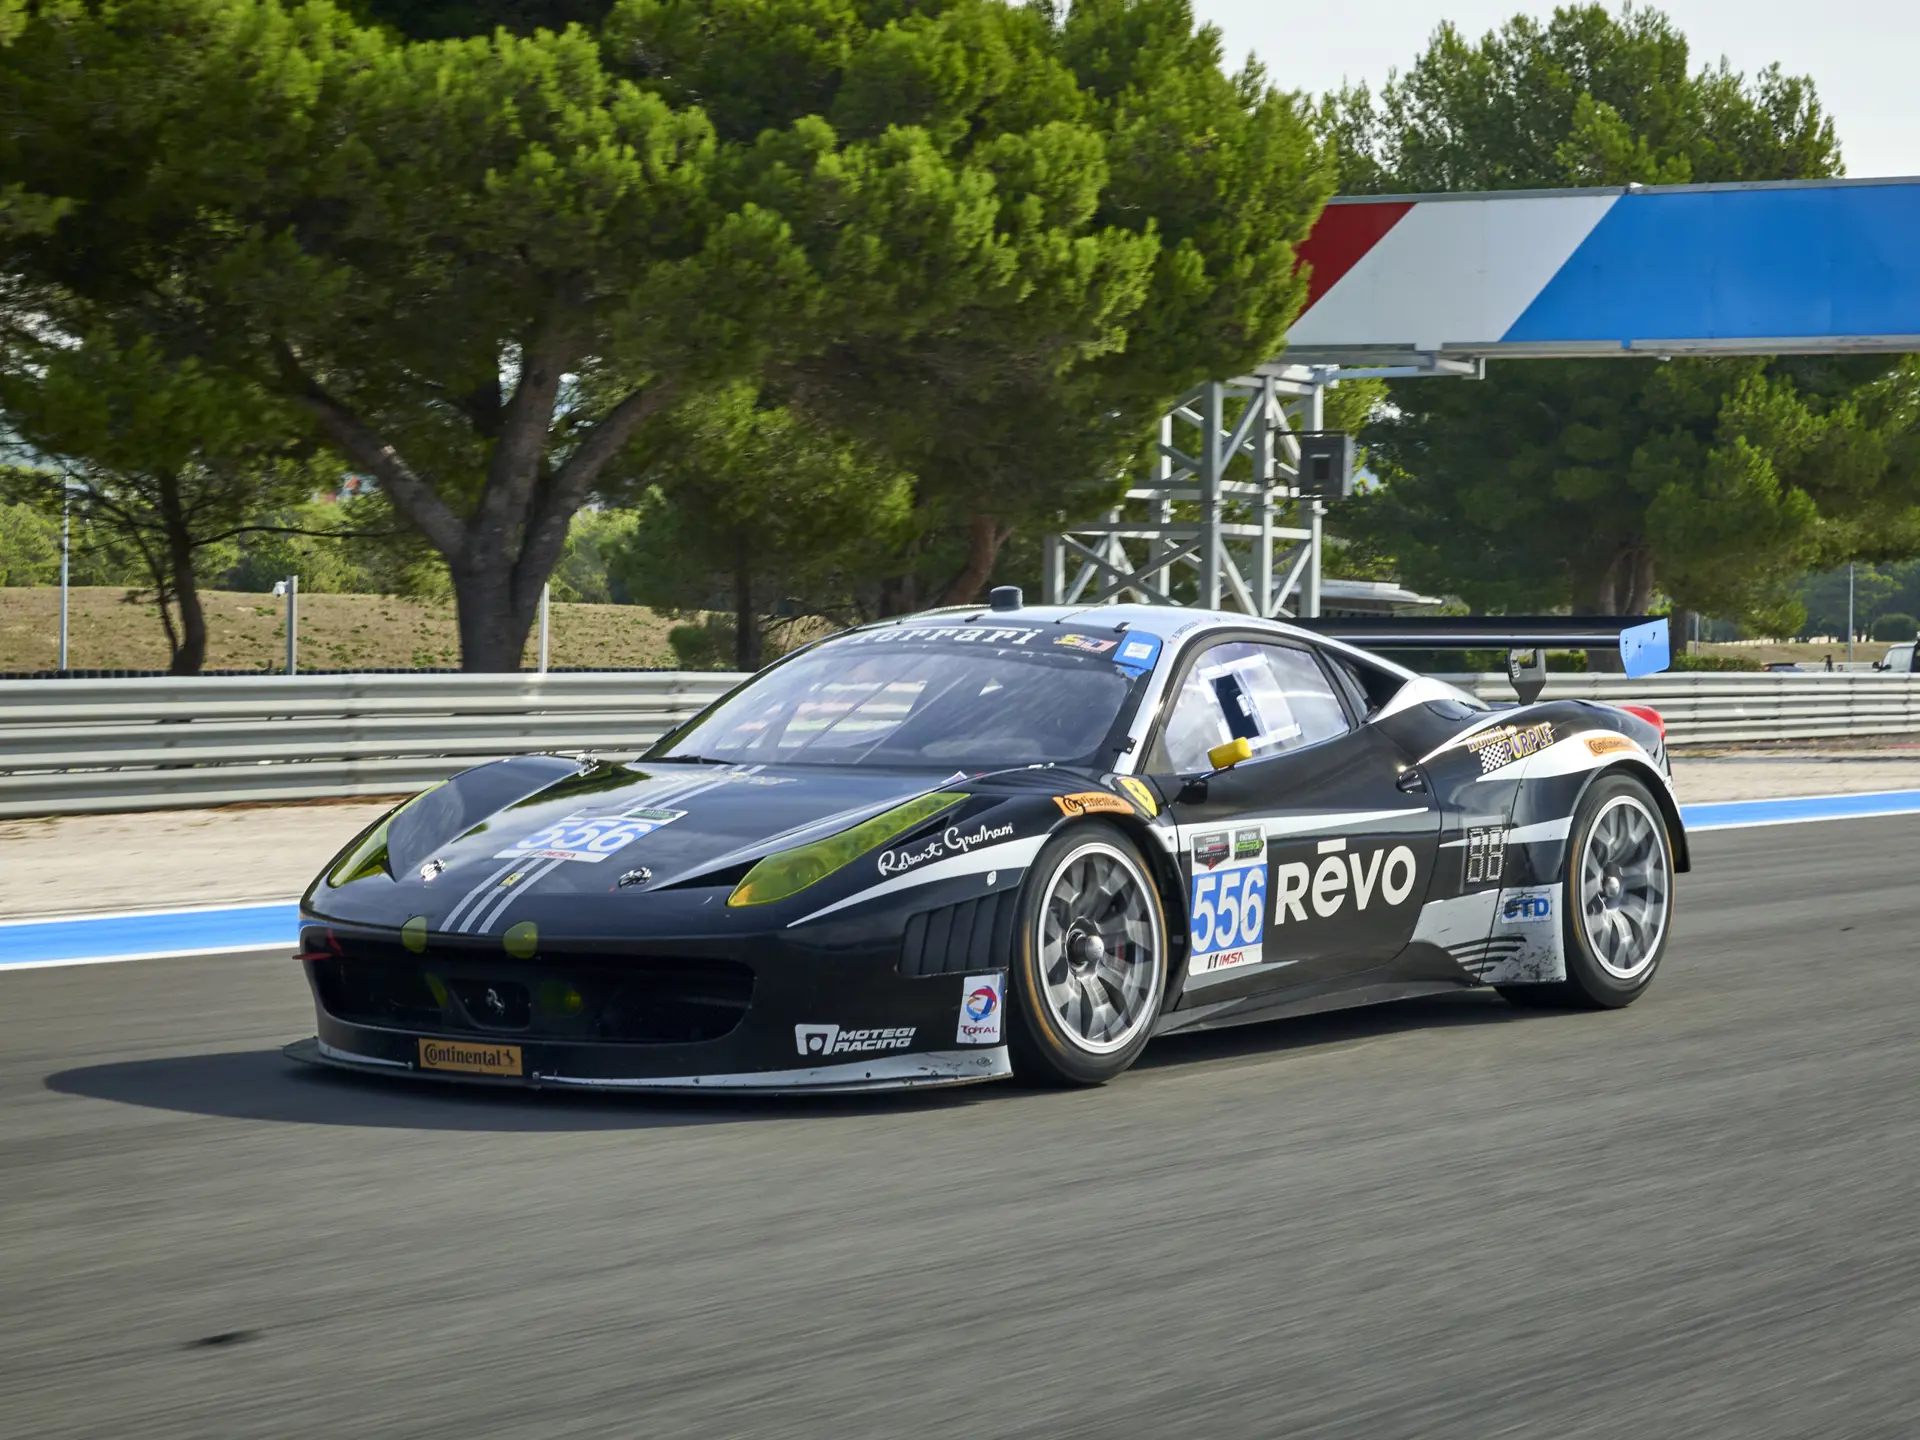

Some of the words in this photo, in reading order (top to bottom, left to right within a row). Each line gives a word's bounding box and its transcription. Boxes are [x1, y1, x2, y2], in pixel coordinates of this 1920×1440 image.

[850, 625, 1044, 645] Ferrari
[1502, 721, 1554, 763] PURPLE
[516, 820, 652, 852] 556
[877, 841, 943, 877] Robert
[943, 823, 1013, 852] Graham
[1191, 867, 1265, 953] 556
[838, 1026, 917, 1041] MOTEGI
[960, 1024, 998, 1035] TOTAL
[424, 1043, 501, 1066] Continental
[833, 1036, 911, 1053] RACING
